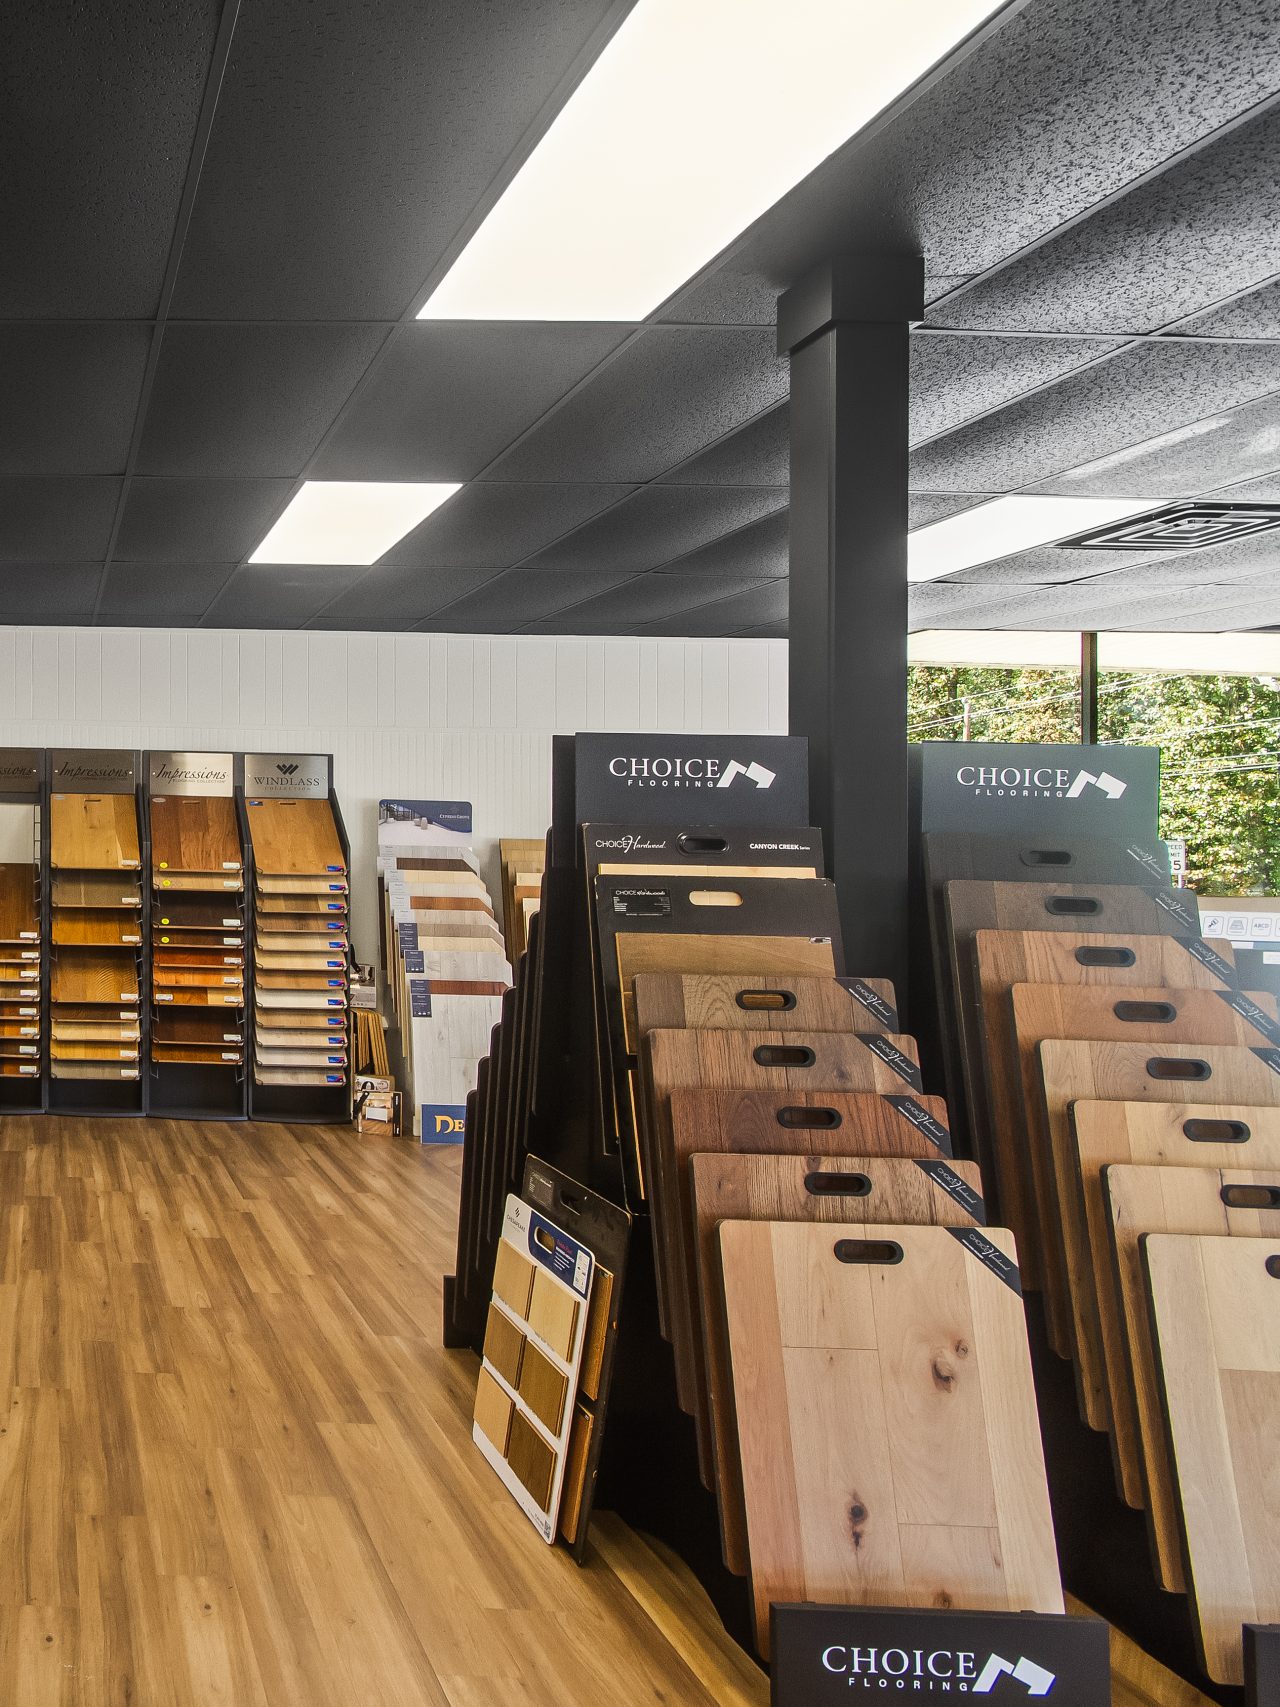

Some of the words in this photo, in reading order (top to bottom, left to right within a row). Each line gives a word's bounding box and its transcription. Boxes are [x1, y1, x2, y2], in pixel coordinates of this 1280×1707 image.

[59, 761, 129, 782] Impressions
[156, 763, 228, 784] Impressions
[609, 757, 720, 779] CHOICE
[957, 766, 1070, 788] CHOICE
[254, 776, 320, 787] WINDLASS
[627, 779, 715, 788] FLOORING
[974, 788, 1063, 798] FLOORING
[595, 839, 628, 848] CHOICE
[434, 1115, 465, 1134] DE
[821, 1645, 977, 1679] CHOICE
[848, 1677, 969, 1692] FLOORING
